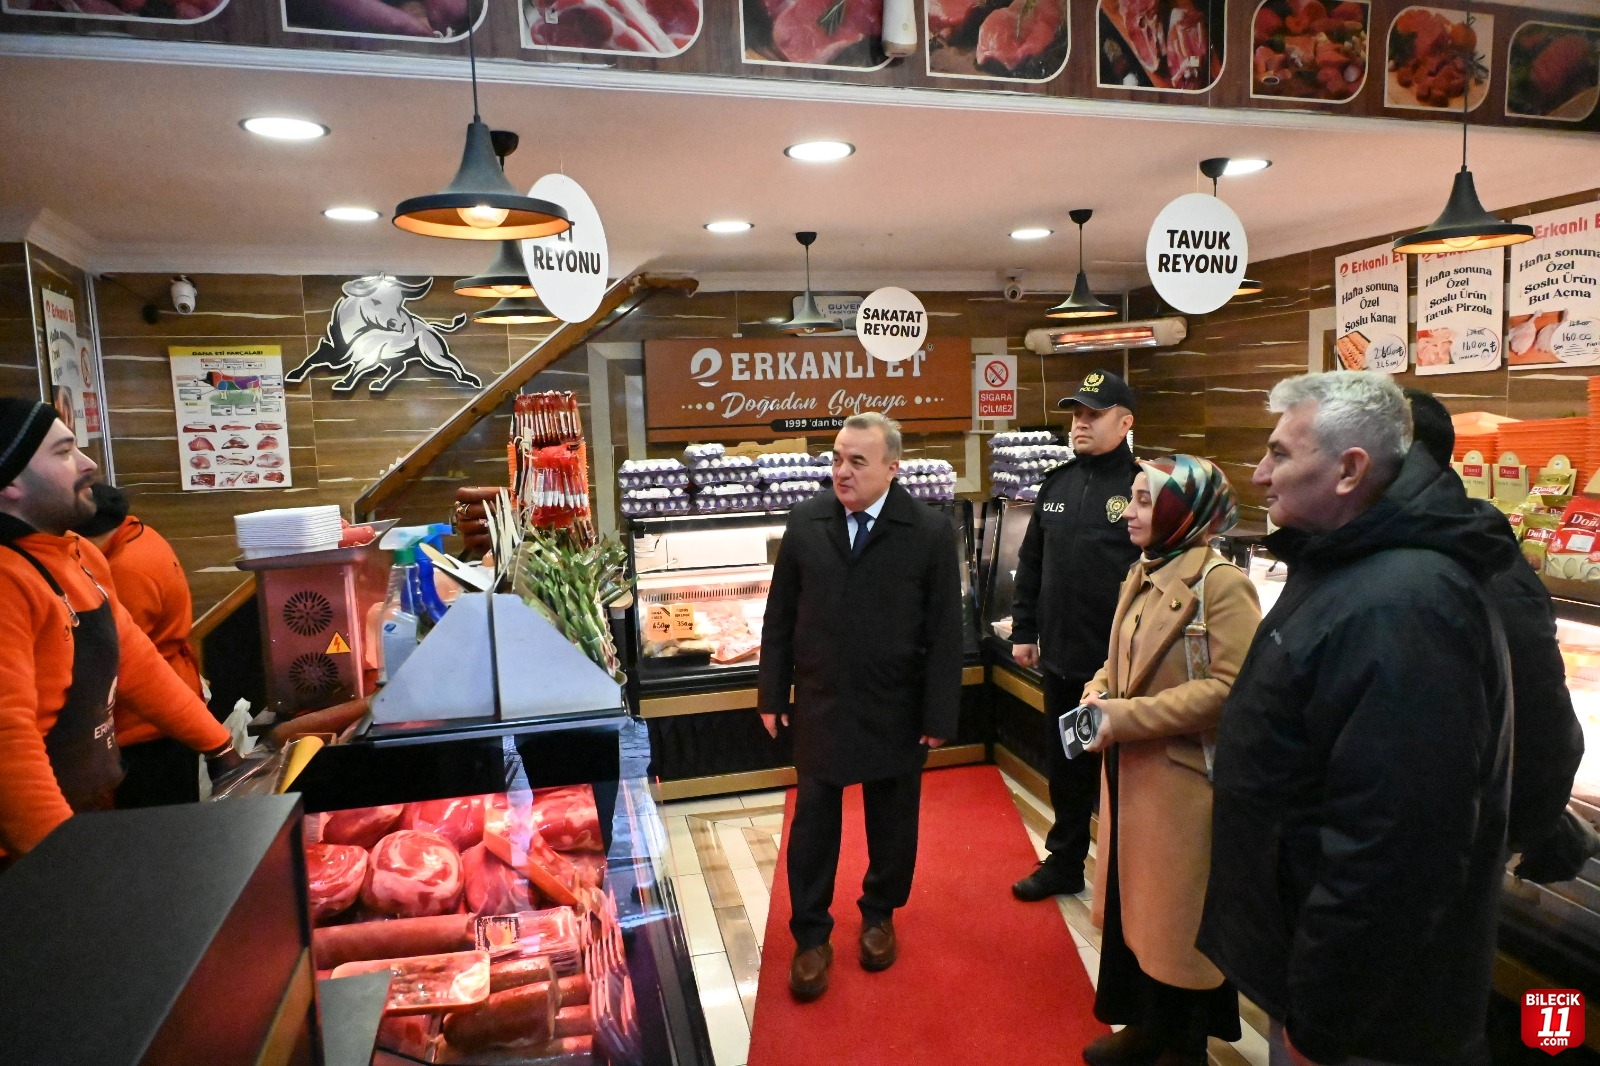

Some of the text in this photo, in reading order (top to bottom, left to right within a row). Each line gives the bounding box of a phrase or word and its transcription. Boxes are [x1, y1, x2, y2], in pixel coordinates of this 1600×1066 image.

[1534, 216, 1588, 240] Erkanlı
[1166, 229, 1231, 250] TAVUK
[533, 245, 601, 275] REYONU
[1158, 253, 1238, 274] REYONU
[1351, 254, 1388, 274] Erkanlı
[1519, 252, 1552, 273] Hafta
[1545, 260, 1575, 273] Özel
[1424, 266, 1493, 288] Hafta sonuna
[1446, 277, 1470, 289] Özel
[1523, 271, 1597, 295] Soslu Ürün
[1341, 282, 1399, 305] Hafta sonuna
[1359, 296, 1380, 310] Özel
[1429, 288, 1487, 309] Soslu Ürün
[1527, 288, 1592, 306] But Açma
[862, 308, 923, 323] SAKATAT
[1345, 313, 1397, 333] Soslu Kanat
[1424, 303, 1493, 324] Tavuk Pirzola
[863, 322, 920, 337] REYONU
[731, 351, 875, 380] ERKANLI
[720, 388, 908, 419] Doğadan Sofraya
[785, 419, 807, 428] 1999
